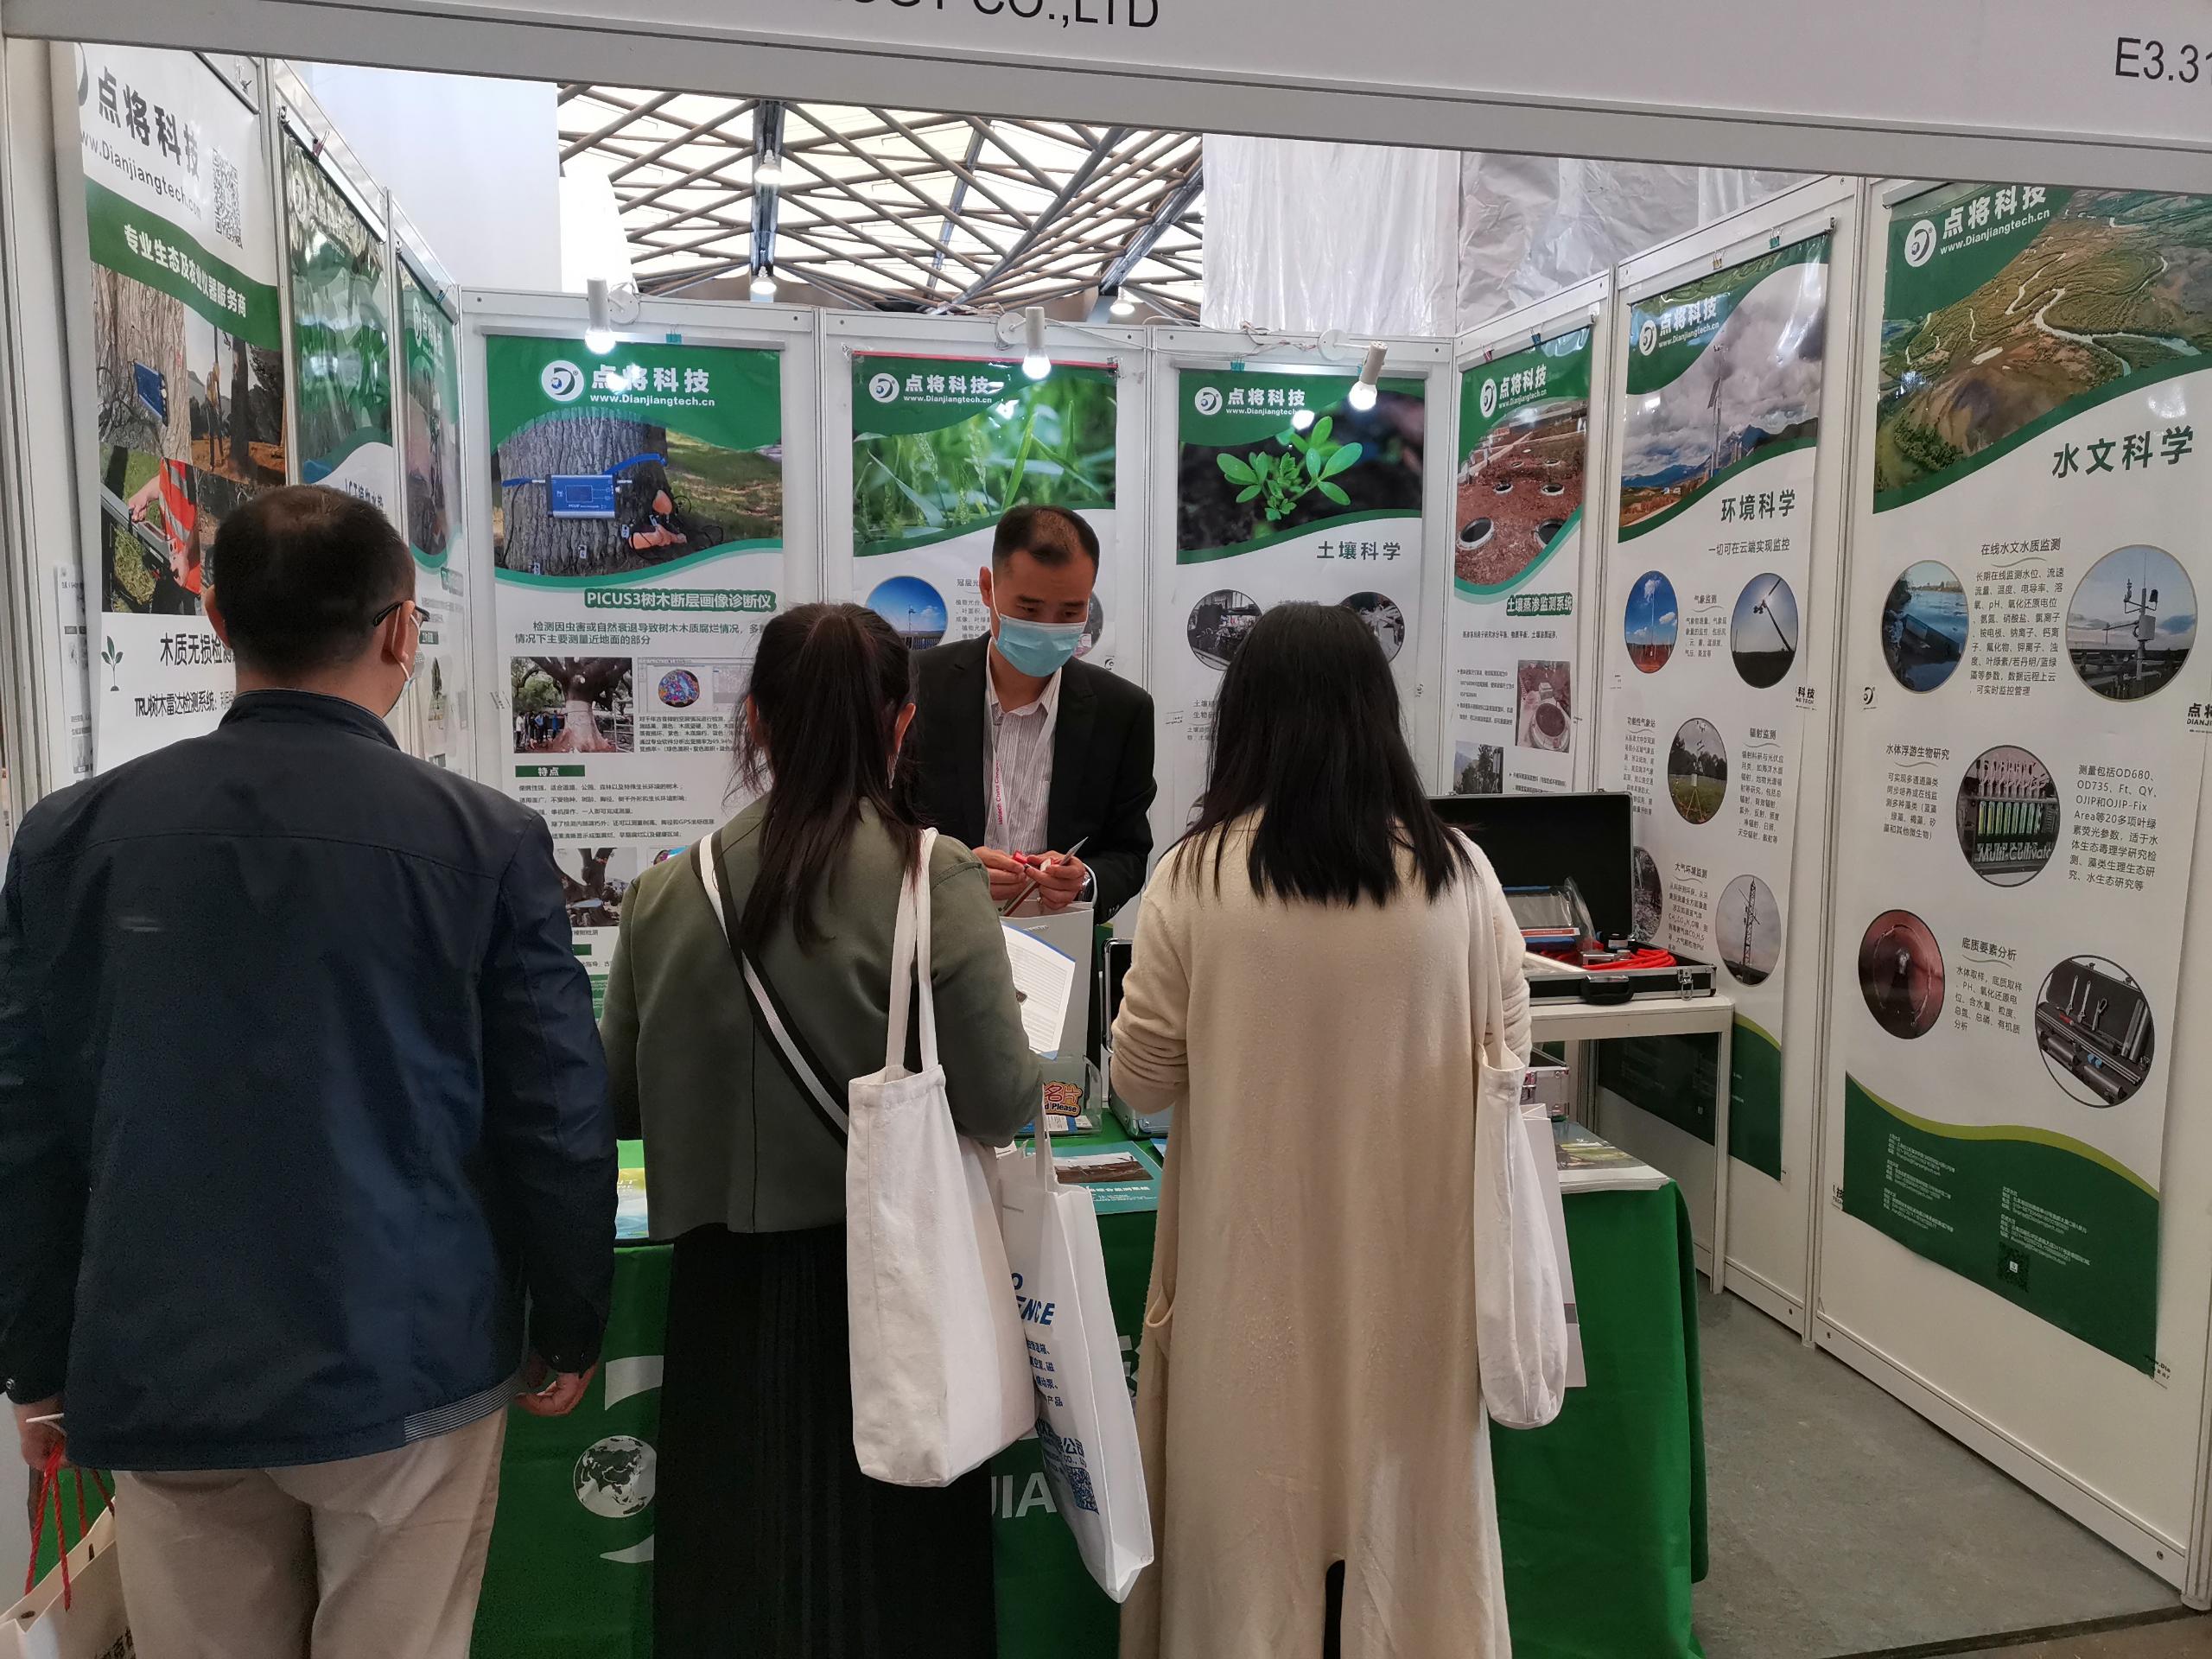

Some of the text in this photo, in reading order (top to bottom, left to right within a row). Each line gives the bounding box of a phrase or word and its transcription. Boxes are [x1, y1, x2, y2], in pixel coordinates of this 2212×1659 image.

[97, 66, 200, 181] 点将科技
[1942, 185, 2047, 238] 点将科技
[1940, 208, 2050, 256] www.Dianjiangtech.cn
[1659, 296, 1718, 338] 点将科技
[905, 374, 989, 394] 点将科技
[1499, 364, 1548, 400] 点将科技
[589, 393, 715, 408] www.Dianjiangtech.cn
[903, 394, 993, 404] www.Dianjiangtech.cn
[1227, 387, 1306, 407] 点将科技
[2051, 424, 2194, 479] 水文科学
[1720, 488, 1796, 524] 环境科学
[1316, 540, 1402, 562] 土壤科学
[1707, 537, 1791, 557] 一切可在云端实现监控
[1980, 537, 2062, 556] 在线水文水质监测
[1975, 567, 2065, 582] 长期在线监测水位、流速
[586, 591, 772, 610] PICUS3树木断层画像诊断仪
[1694, 594, 1718, 605] 气象监测
[159, 632, 235, 667] 木质无损检测
[514, 632, 652, 646] 情况下主要测量近地面的部分
[1749, 728, 1777, 741] 辐射监测
[1885, 742, 1950, 761] 水体浮游生物研究
[537, 766, 560, 777] 特点
[2075, 794, 2148, 812] OJIP和OJIP-Fix
[2074, 809, 2158, 830] Area等20多项叶绿
[2072, 823, 2158, 846] 素荧光参数，适于水
[2071, 839, 2158, 862] 体生态毒理学研究检
[2069, 855, 2156, 878] 测、藻类生理生态研
[2068, 868, 2145, 892] 究、水生态研究等
[1961, 937, 2018, 962] 底质要素分析
[1955, 964, 2024, 993] 水体取样，底质取样
[1954, 1018, 1968, 1033] 分析
[1045, 1083, 1081, 1105] 名片
[1052, 1103, 1077, 1113] Please
